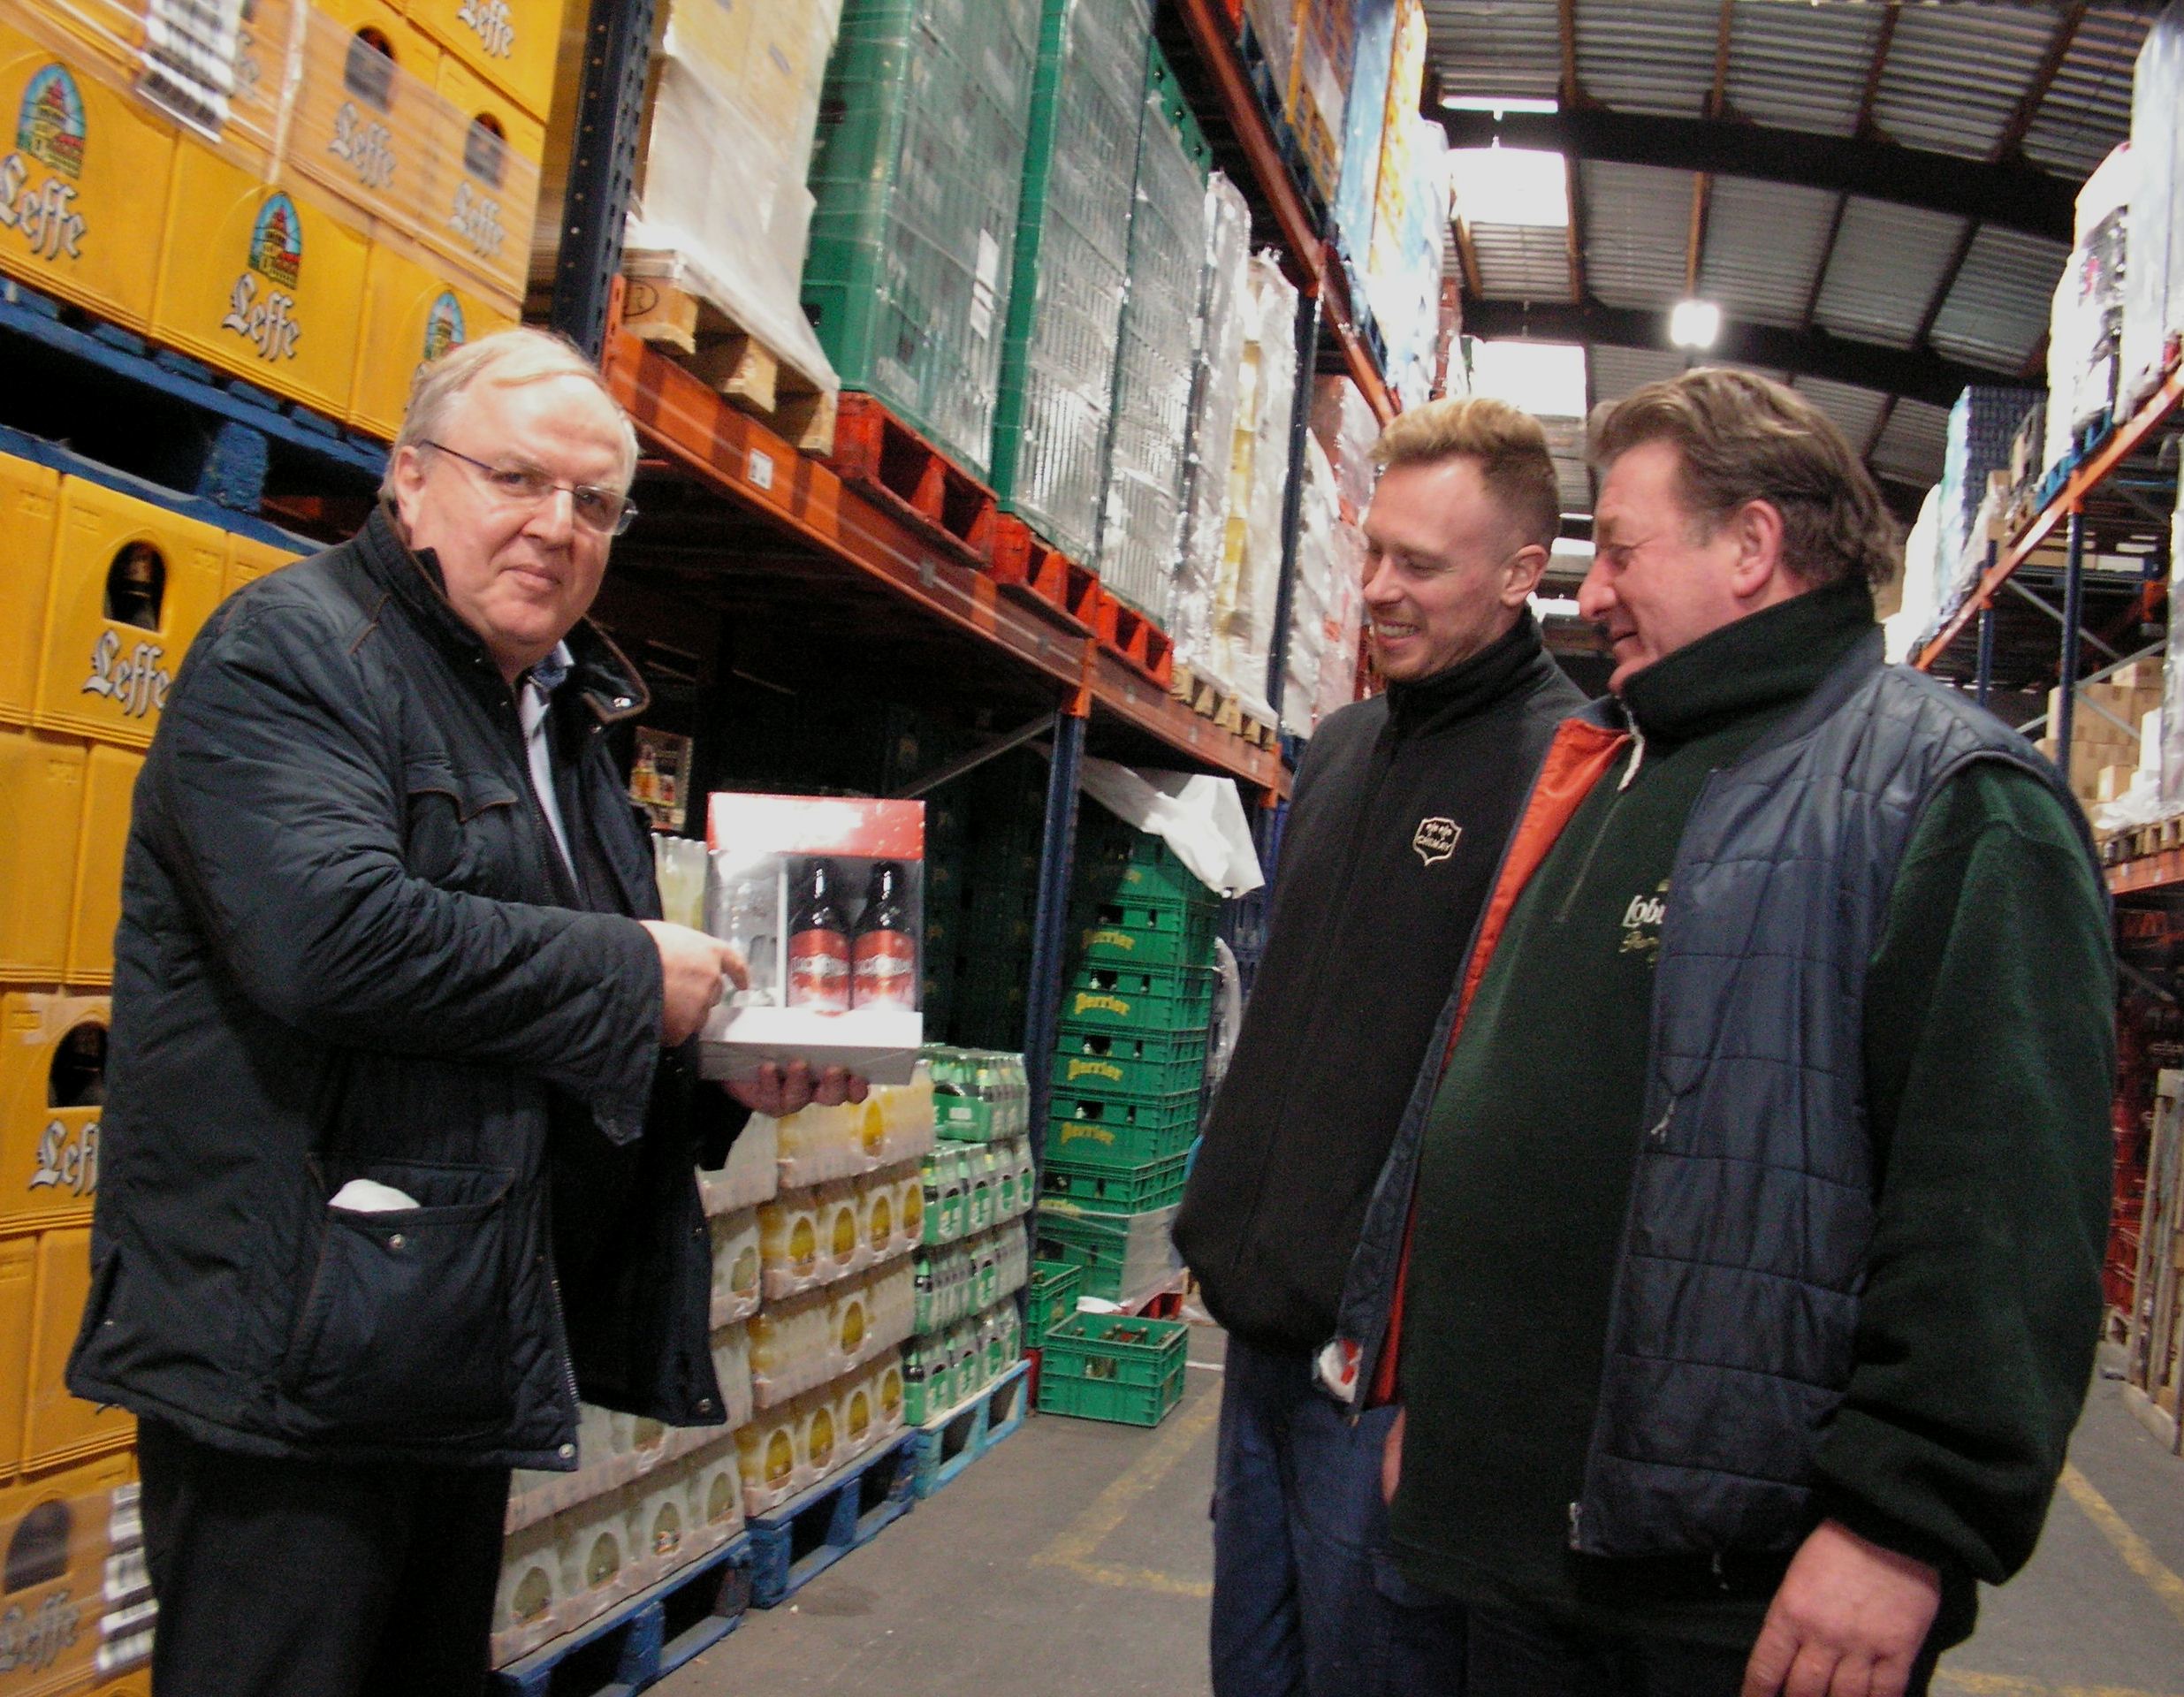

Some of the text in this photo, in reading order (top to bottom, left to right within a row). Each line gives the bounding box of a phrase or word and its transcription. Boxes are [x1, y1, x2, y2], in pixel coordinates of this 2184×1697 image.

[328, 103, 396, 188] Leffe
[0, 152, 87, 262] Leffe
[447, 179, 504, 258] Leffe
[221, 272, 301, 363] Leffe
[81, 628, 171, 719] Leffe
[27, 1118, 100, 1199] Leff
